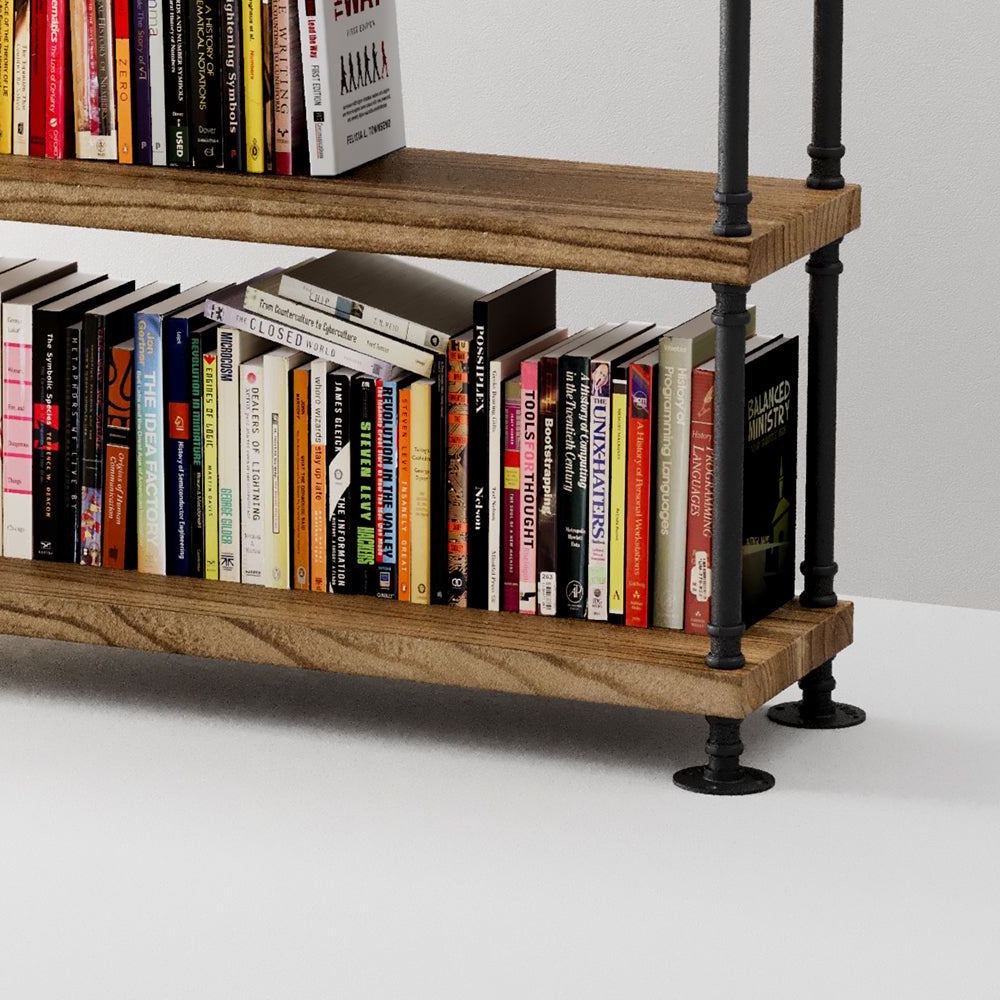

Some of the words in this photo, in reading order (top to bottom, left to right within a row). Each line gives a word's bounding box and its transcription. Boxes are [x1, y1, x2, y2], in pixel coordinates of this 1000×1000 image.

[308, 19, 316, 33] Lead
[309, 35, 317, 43] the
[309, 46, 318, 58] Way
[120, 59, 128, 102] ZERO
[228, 73, 238, 133] Symbols
[220, 332, 232, 381] MICROCOSM
[236, 315, 247, 325] THE
[249, 318, 302, 347] CLOSED
[306, 340, 335, 357] WORLD
[144, 370, 156, 408] THE
[206, 368, 214, 403] ENGINES
[476, 325, 484, 413] POSSIPLEX
[676, 368, 687, 410] History
[206, 408, 214, 419] OF
[661, 367, 674, 456] Programming
[676, 413, 686, 425] of
[748, 380, 790, 421] BALANCED
[748, 400, 789, 442] MINISTRY
[144, 413, 157, 456] IDEA
[383, 387, 393, 464] REVOLUTION
[252, 440, 259, 454] OF
[361, 421, 370, 477] STEVEN
[541, 418, 553, 515] Bootstrapping
[383, 469, 393, 482] IN
[592, 405, 606, 538] UNIX-HATERS
[690, 446, 702, 516] LANGUAGES
[145, 460, 159, 544] FACTORY
[221, 488, 232, 516] GEORGE
[361, 486, 371, 520] LEVY
[383, 486, 393, 509] THE
[475, 487, 484, 530] Nelson
[660, 461, 672, 534] Languages
[221, 518, 232, 544] GILDER
[357, 527, 374, 564] HACKERS
[383, 513, 393, 557] VALLEY
